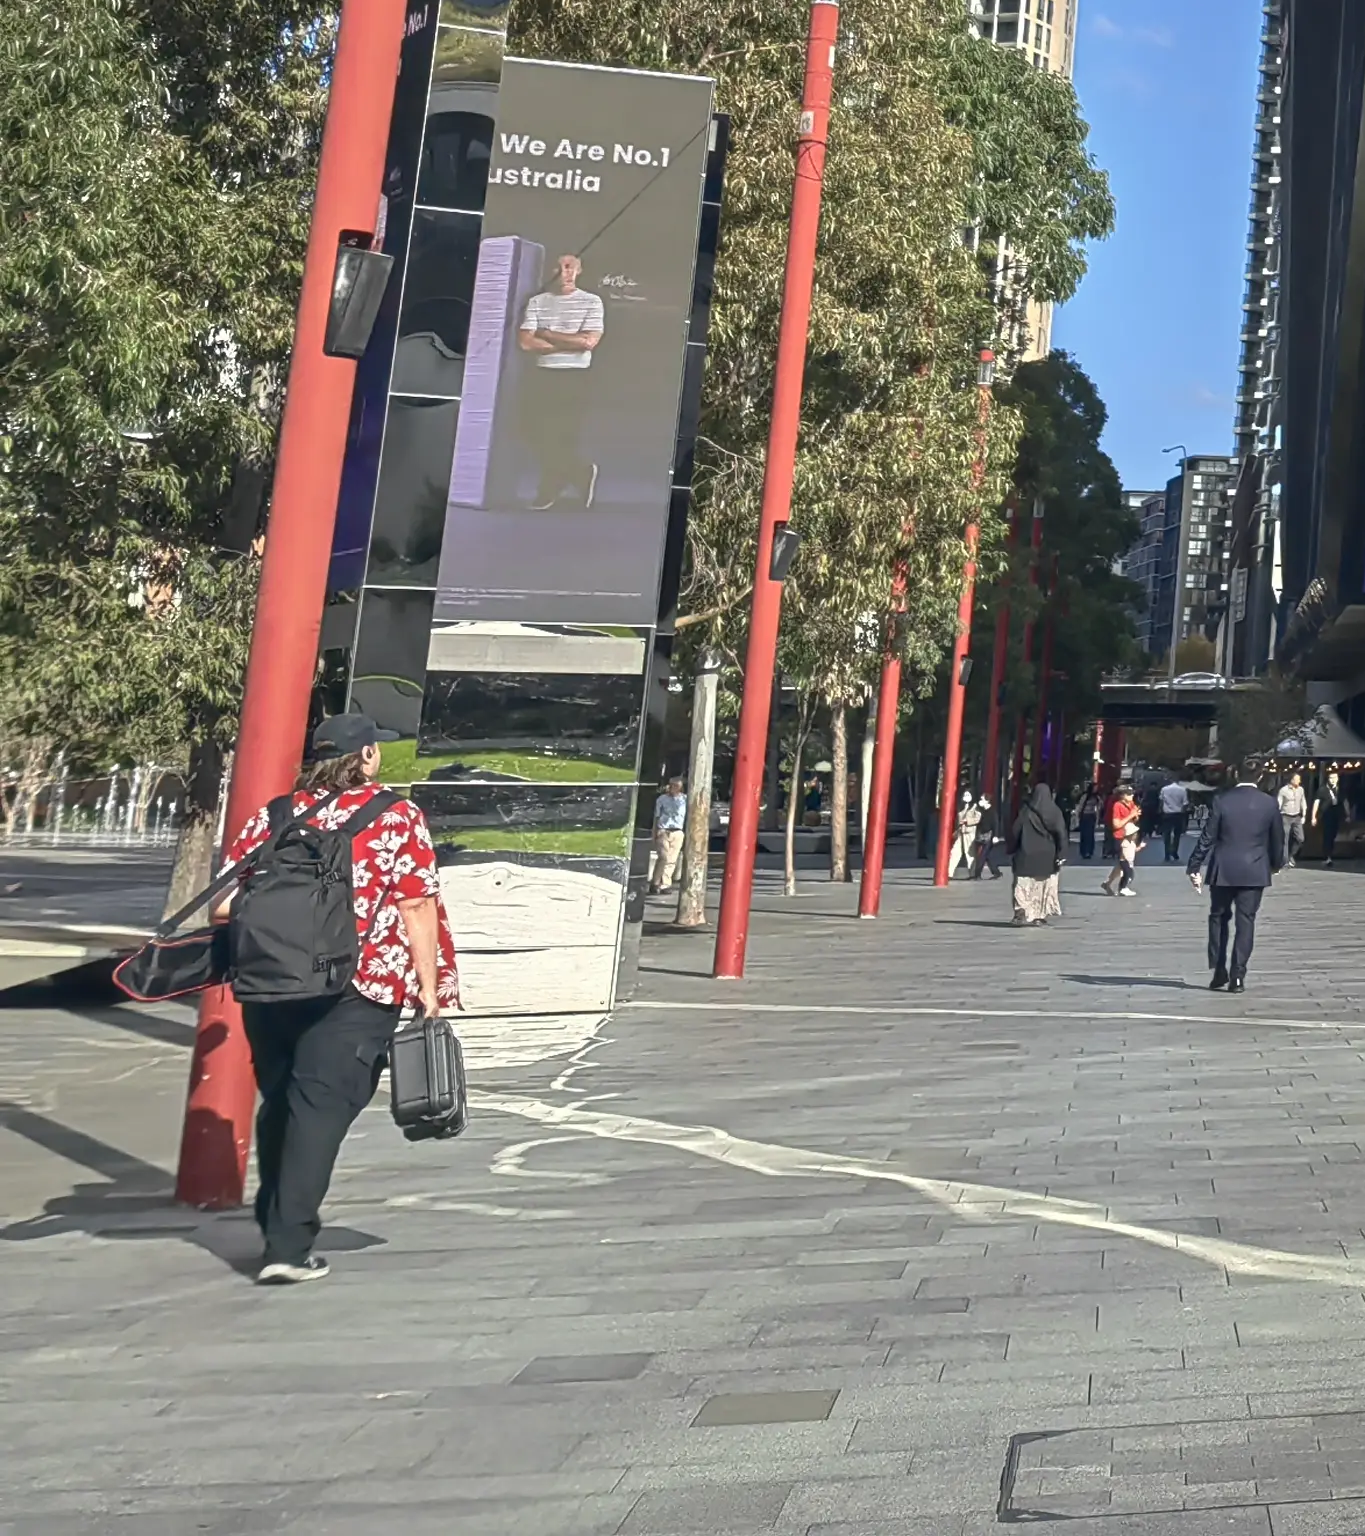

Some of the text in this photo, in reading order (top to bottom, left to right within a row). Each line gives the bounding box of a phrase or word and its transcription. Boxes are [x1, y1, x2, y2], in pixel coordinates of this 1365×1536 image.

[499, 132, 671, 168] We Are No.1
[487, 166, 601, 193] ustralia
